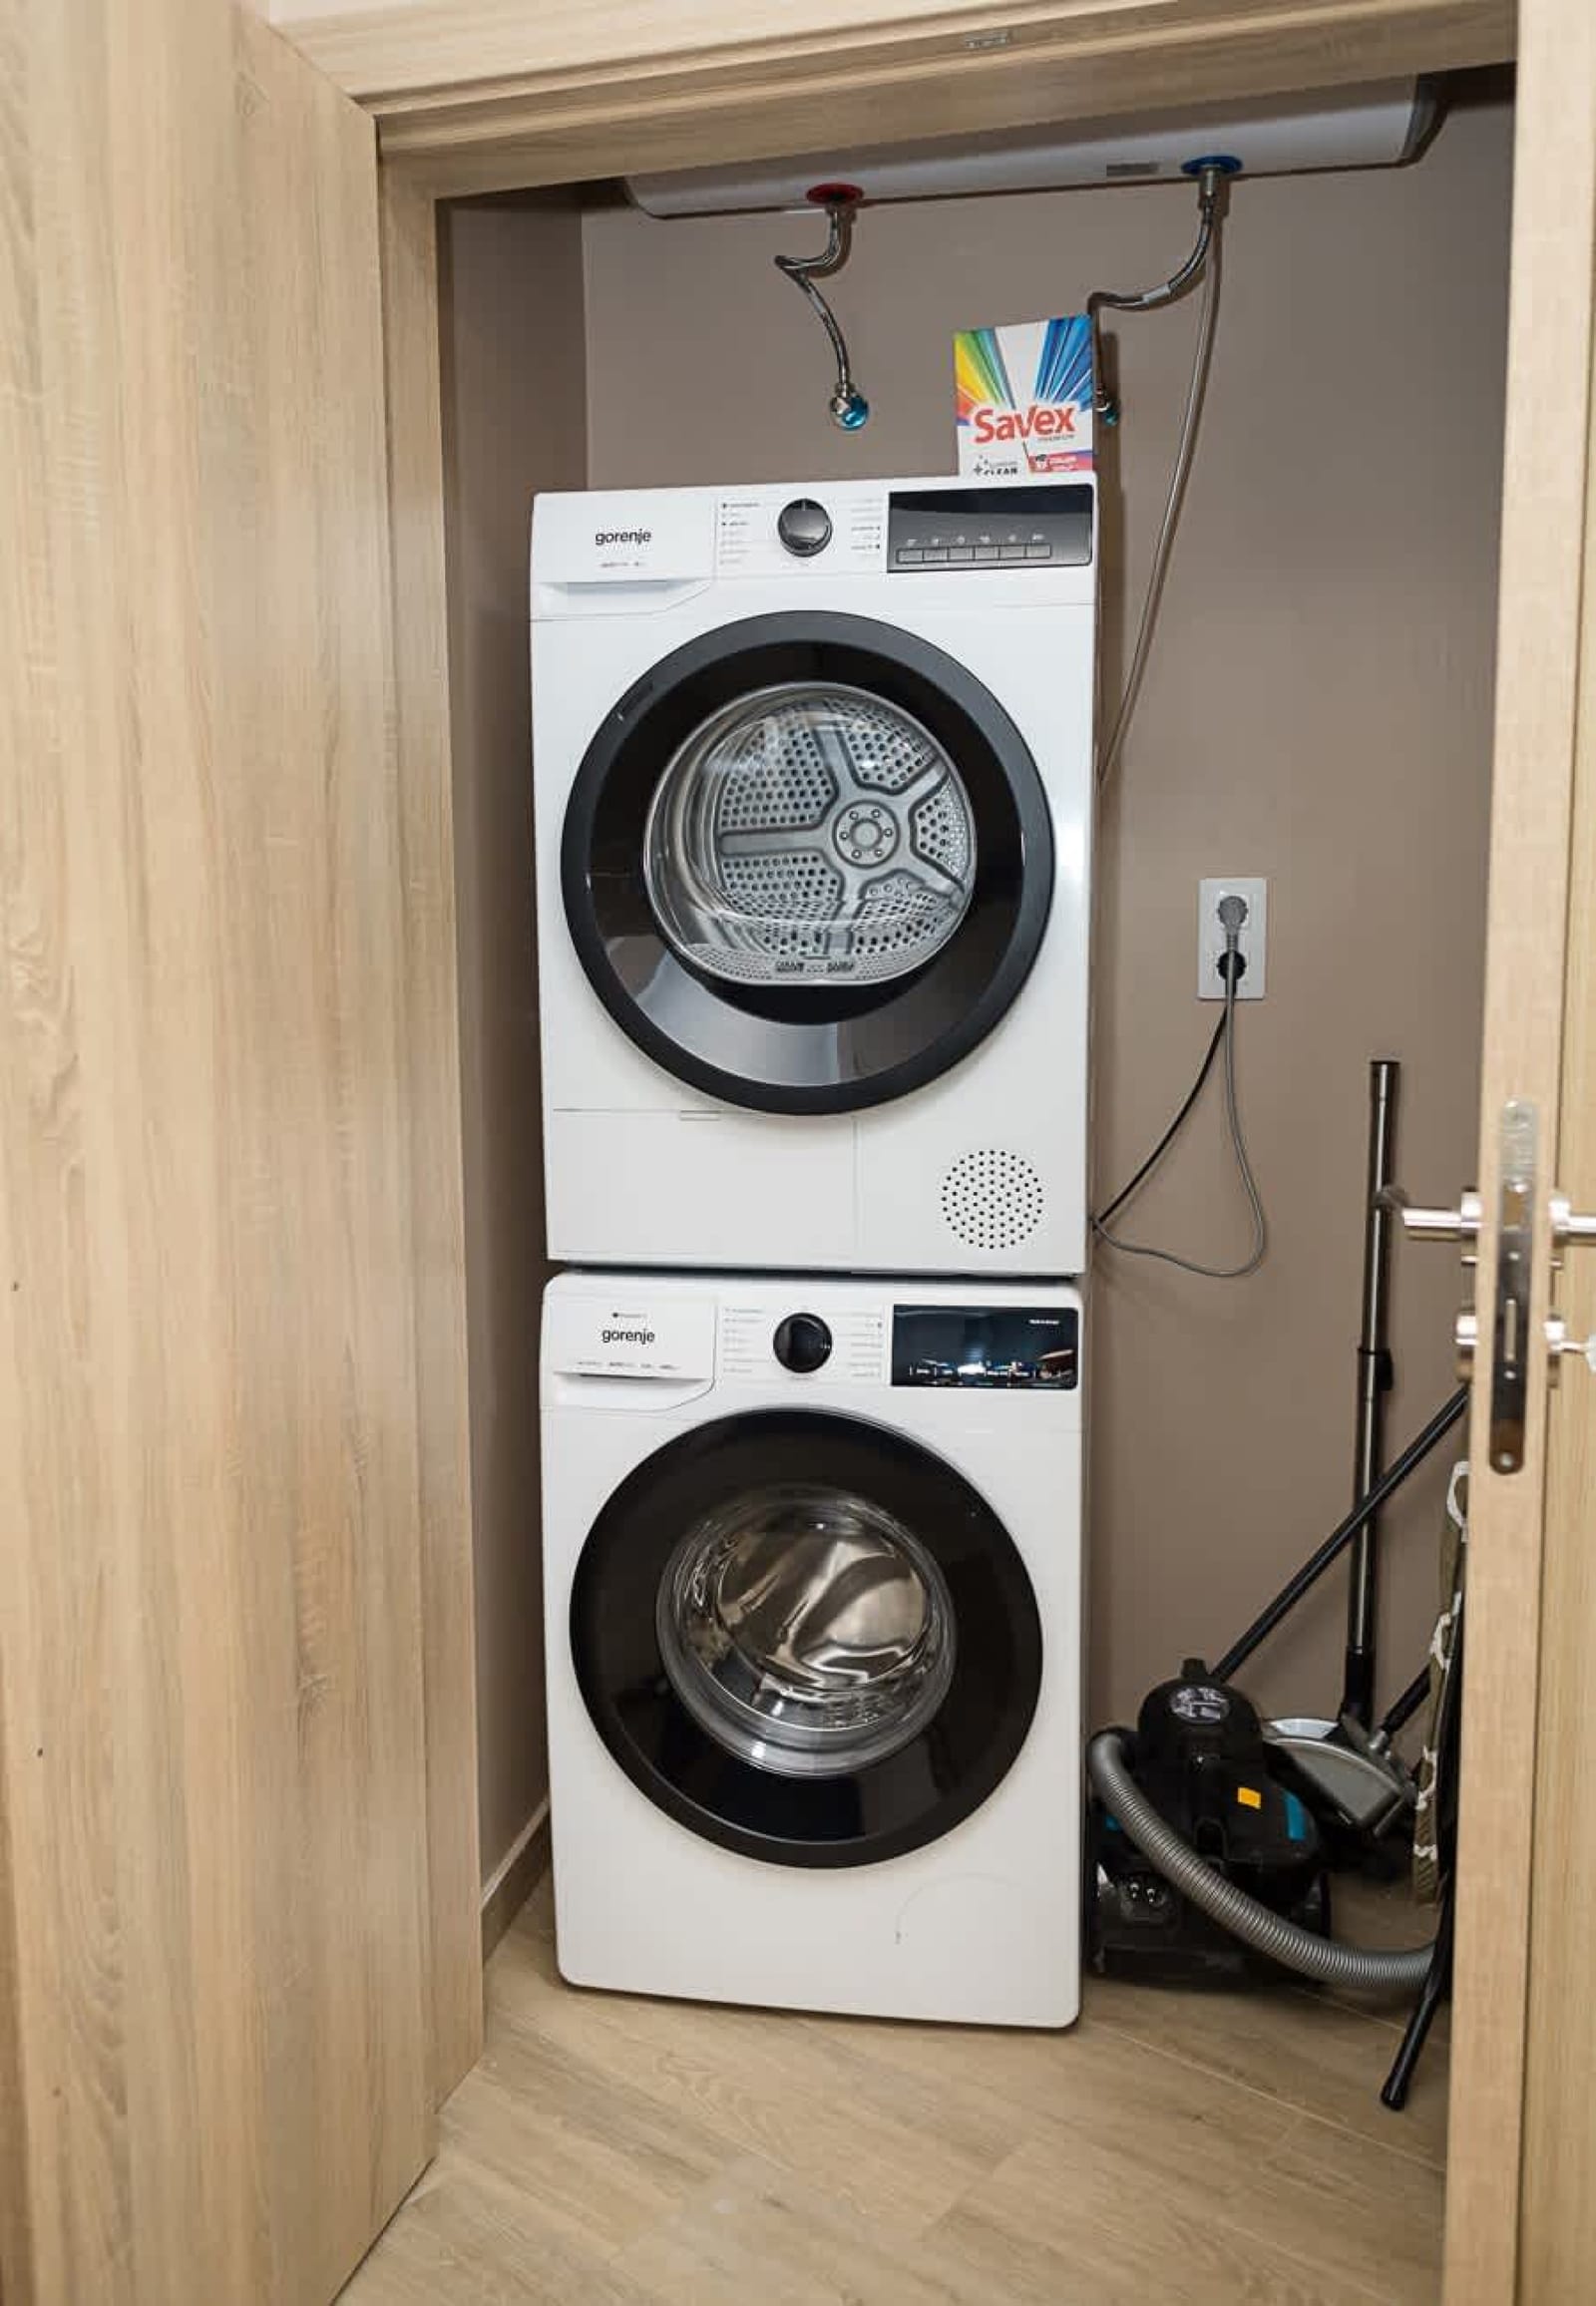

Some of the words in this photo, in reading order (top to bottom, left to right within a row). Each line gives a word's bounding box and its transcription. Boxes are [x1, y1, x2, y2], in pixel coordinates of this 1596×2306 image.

[974, 404, 1076, 444] Savex
[595, 528, 652, 546] gorenje
[601, 1328, 655, 1345] gorenje
